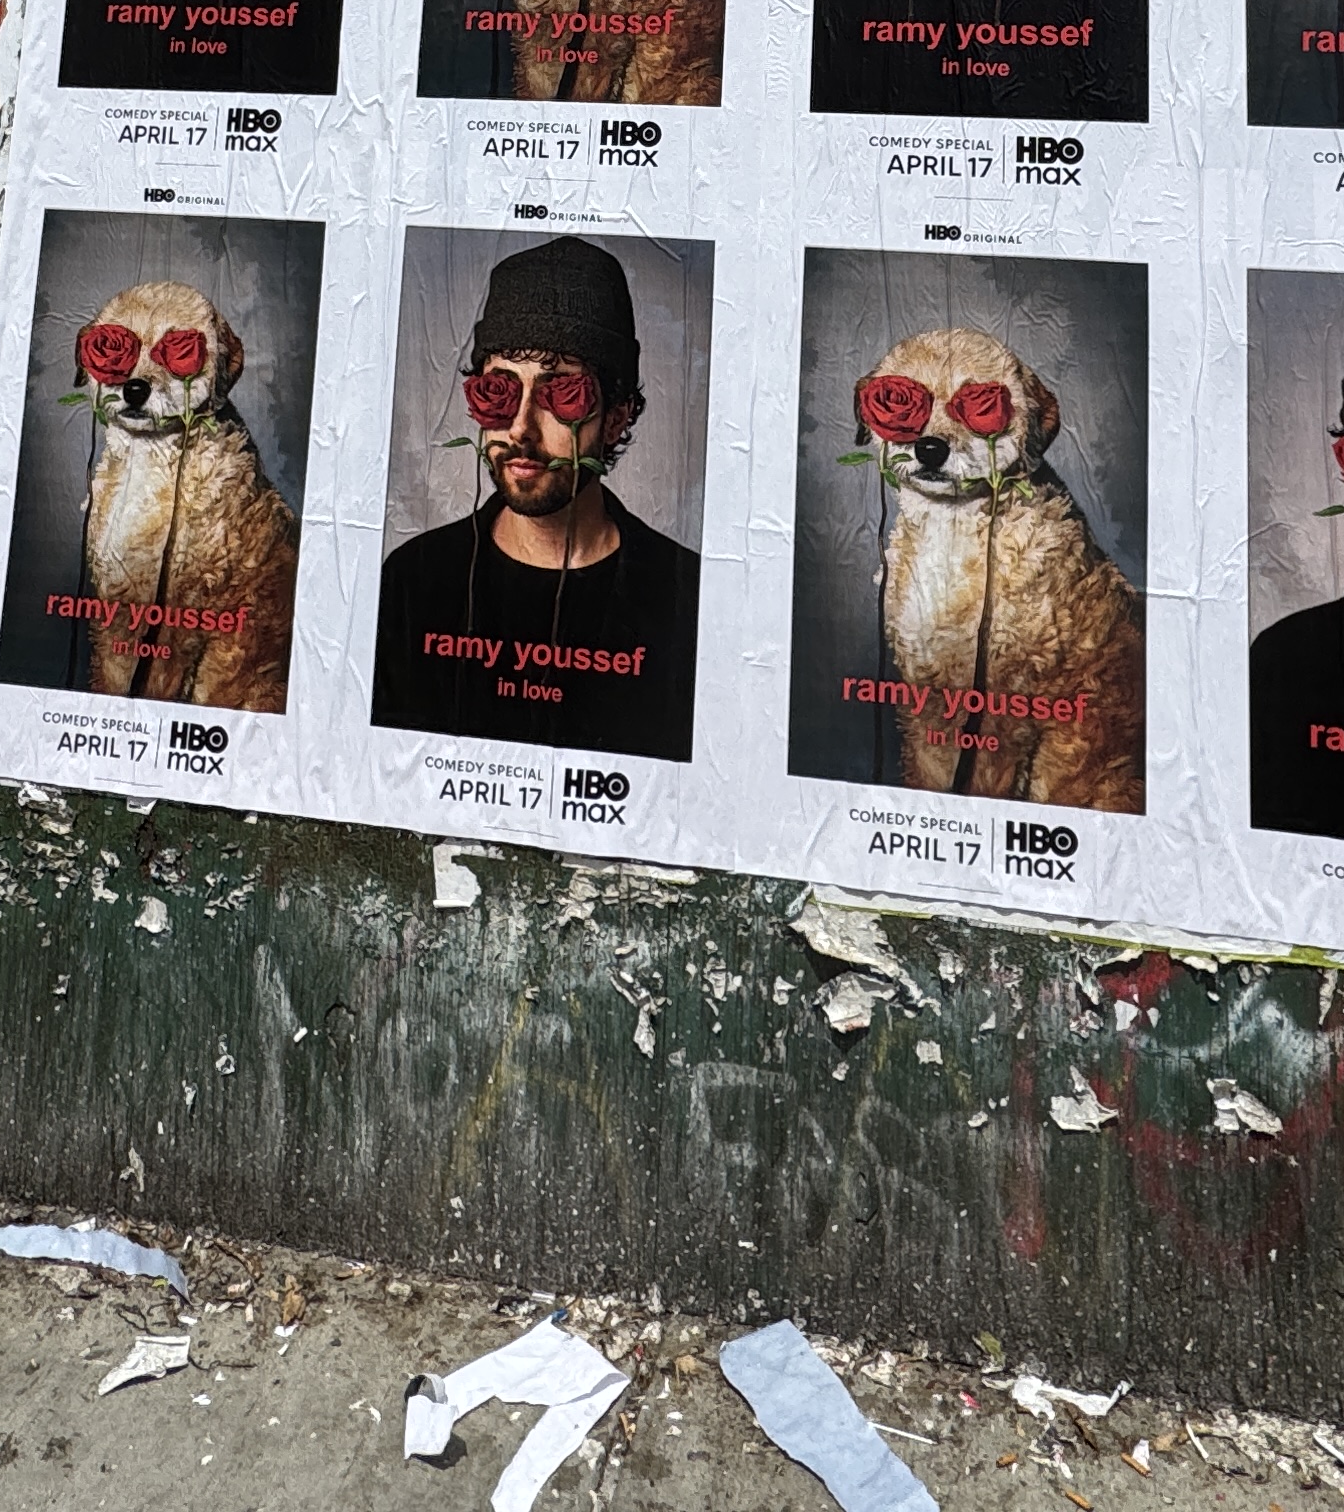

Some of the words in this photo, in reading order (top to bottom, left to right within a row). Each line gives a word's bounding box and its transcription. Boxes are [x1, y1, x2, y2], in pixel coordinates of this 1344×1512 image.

[106, 3, 176, 30] ramy
[184, 2, 299, 30] youssef
[465, 10, 540, 38] ramy
[550, 9, 677, 38] youssef
[169, 37, 185, 54] in
[192, 38, 228, 55] love
[862, 20, 946, 50] ramy
[956, 19, 1094, 50] youssef
[537, 47, 552, 62] in
[559, 47, 599, 64] love
[942, 58, 960, 75] in
[967, 58, 1010, 76] love
[104, 108, 157, 121] COMEDY
[160, 110, 209, 122] SPECIAL
[227, 108, 282, 134] HBO
[466, 120, 524, 133] COMEDY
[528, 122, 581, 135] SPECIAL
[118, 126, 179, 146] APRIL
[186, 127, 208, 146] 17
[225, 135, 278, 152] max
[600, 120, 662, 147] HBO
[869, 136, 931, 148] COMEDY
[936, 138, 994, 151] SPECIAL
[483, 138, 549, 158] APRIL
[557, 140, 580, 160] 17
[599, 149, 658, 167] max
[1016, 136, 1084, 164] HBO
[887, 155, 962, 176] APRIL
[968, 158, 993, 178] 17
[1016, 166, 1082, 186] max
[144, 188, 176, 202] HBO
[177, 196, 225, 206] ORIGINAL
[514, 204, 548, 220] HBO
[550, 212, 602, 222] ORIGINAL
[925, 224, 962, 240] HBO
[964, 234, 1022, 244] ORIGINAL
[46, 593, 119, 627] ramy
[128, 603, 248, 633] youssef
[112, 637, 130, 654] in
[134, 638, 171, 660] love
[424, 632, 503, 668] ramy
[514, 641, 646, 676] youssef
[498, 677, 516, 696] in
[523, 680, 563, 702] love
[842, 677, 931, 716] ramy
[942, 688, 1088, 724] youssef
[42, 712, 97, 728] COMEDY
[101, 718, 150, 734] SPECIAL
[57, 732, 120, 759] APRIL
[128, 741, 148, 762] 17
[170, 721, 229, 754] HBO
[926, 726, 946, 745] in
[954, 728, 1000, 752] love
[168, 750, 224, 776] max
[425, 756, 484, 774] COMEDY
[488, 764, 544, 781] SPECIAL
[439, 778, 511, 806] APRIL
[519, 788, 542, 810] 17
[564, 768, 630, 801] HBO
[562, 800, 626, 825] max
[849, 809, 916, 826] COMEDY
[920, 816, 982, 836] SPECIAL
[868, 832, 946, 862] APRIL
[954, 841, 981, 866] 17
[1006, 821, 1078, 857] HBO
[1006, 854, 1076, 882] max
